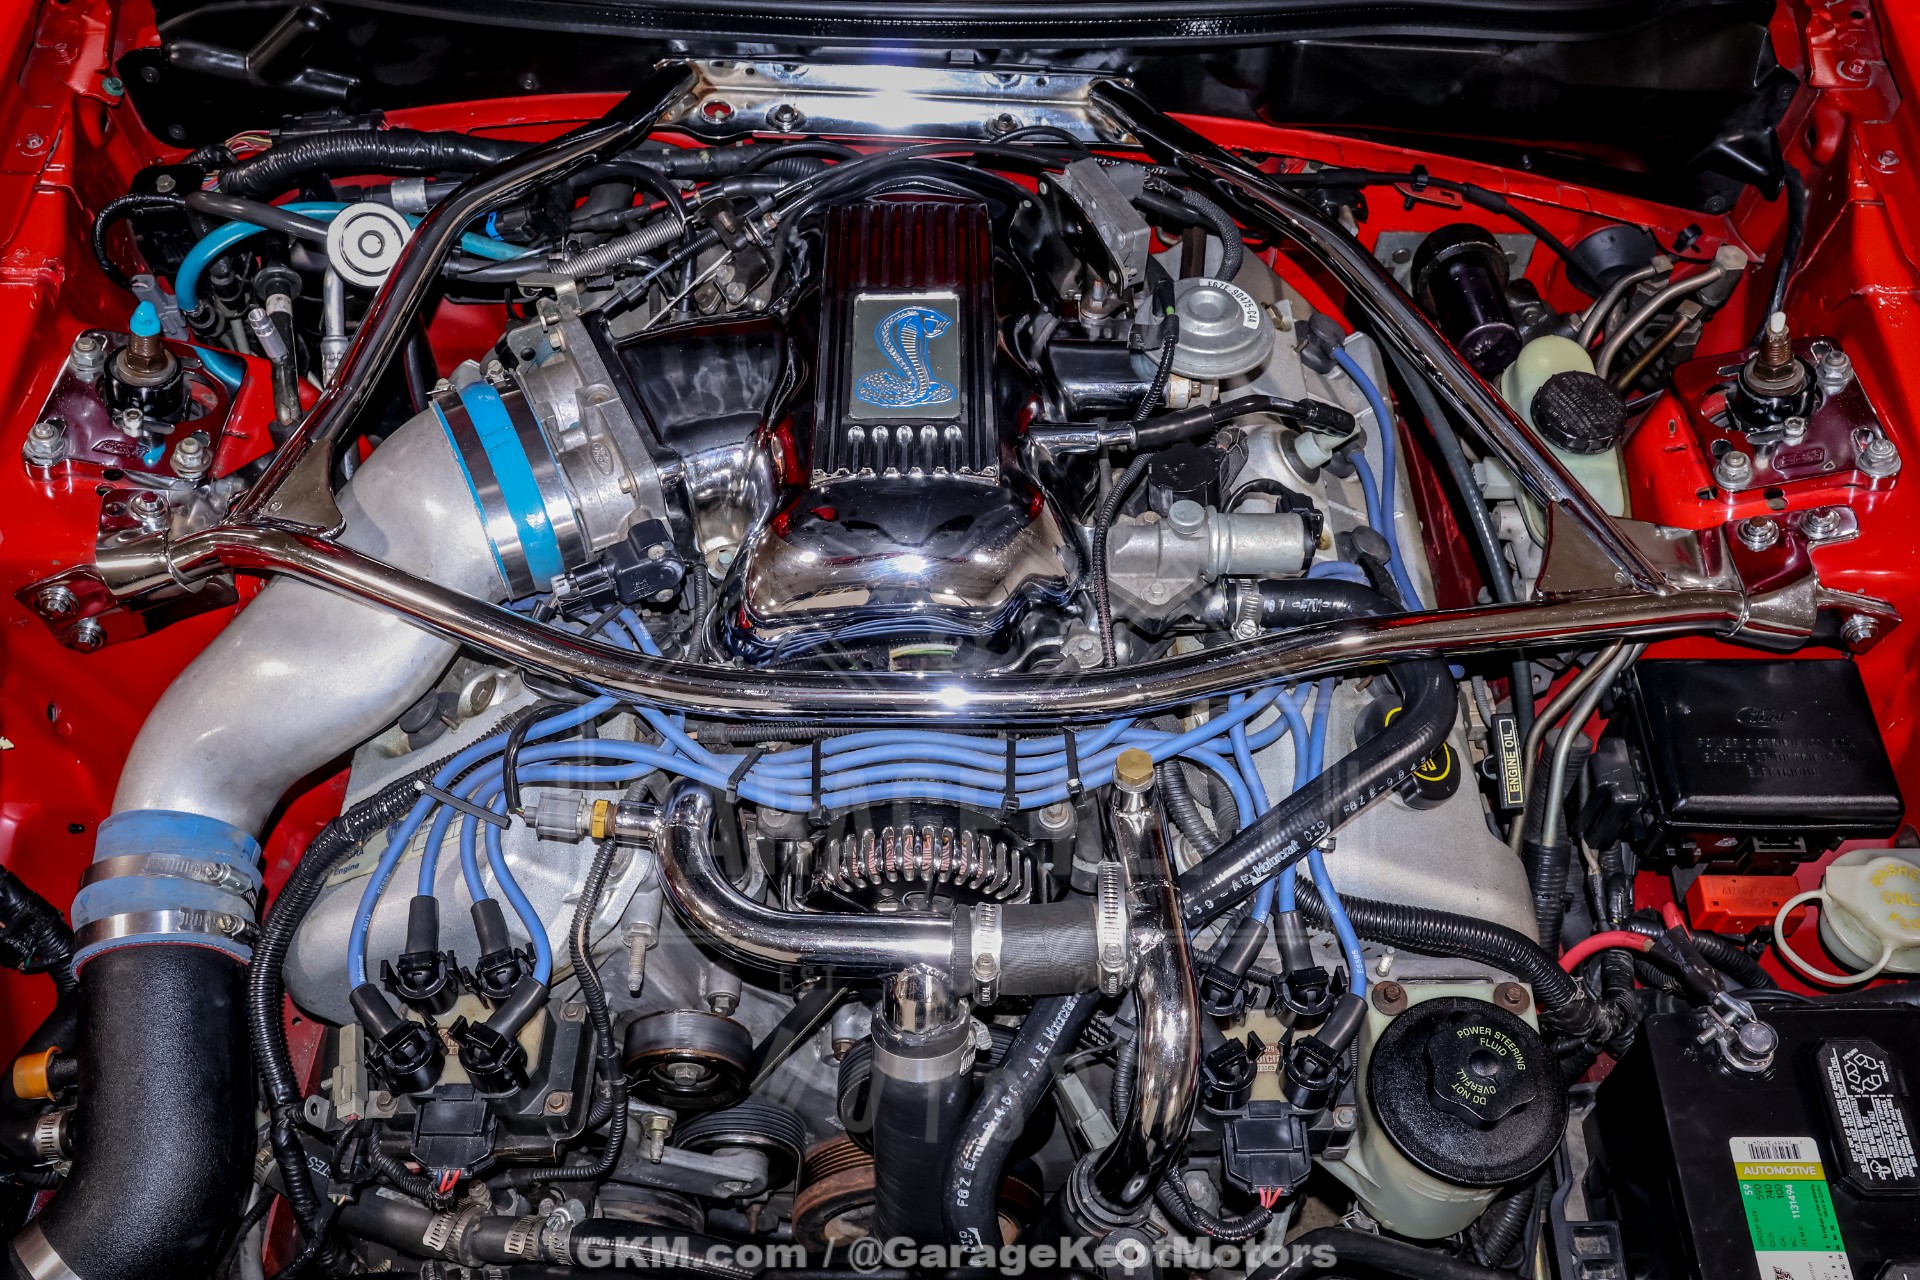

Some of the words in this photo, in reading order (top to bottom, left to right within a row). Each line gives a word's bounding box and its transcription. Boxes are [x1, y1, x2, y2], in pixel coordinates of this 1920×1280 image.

[1503, 729, 1514, 747] OIL
[1506, 751, 1520, 793] ENGINE
[333, 861, 361, 877] Engine
[1871, 863, 1920, 887] WASHE
[1881, 891, 1920, 908] ONL
[1889, 912, 1920, 931] FLU
[1456, 1026, 1492, 1039] POWER
[1493, 1031, 1526, 1071] STEERING
[1479, 1037, 1508, 1056] FLUID
[1456, 1068, 1497, 1094] OVERFILL
[1451, 1083, 1471, 1100] NOT
[1472, 1095, 1487, 1105] DO
[1862, 1116, 1871, 1126] GET
[1858, 1129, 1868, 1142] EYES
[1871, 1124, 1881, 1136] HELP
[1862, 1143, 1873, 1158] FLUSH
[1871, 1146, 1880, 1158] WITH
[1876, 1138, 1887, 1158] MEDICAL
[1743, 1165, 1817, 1176] AUTOMOTIVE
[1742, 1183, 1753, 1195] 59
[1752, 1183, 1764, 1200] 590
[1763, 1183, 1774, 1199] 740
[1773, 1183, 1785, 1199] 100
[1784, 1183, 1801, 1219] 1131494
[1754, 1223, 1765, 1247] GROUP
[1799, 1231, 1808, 1246] ITEM
